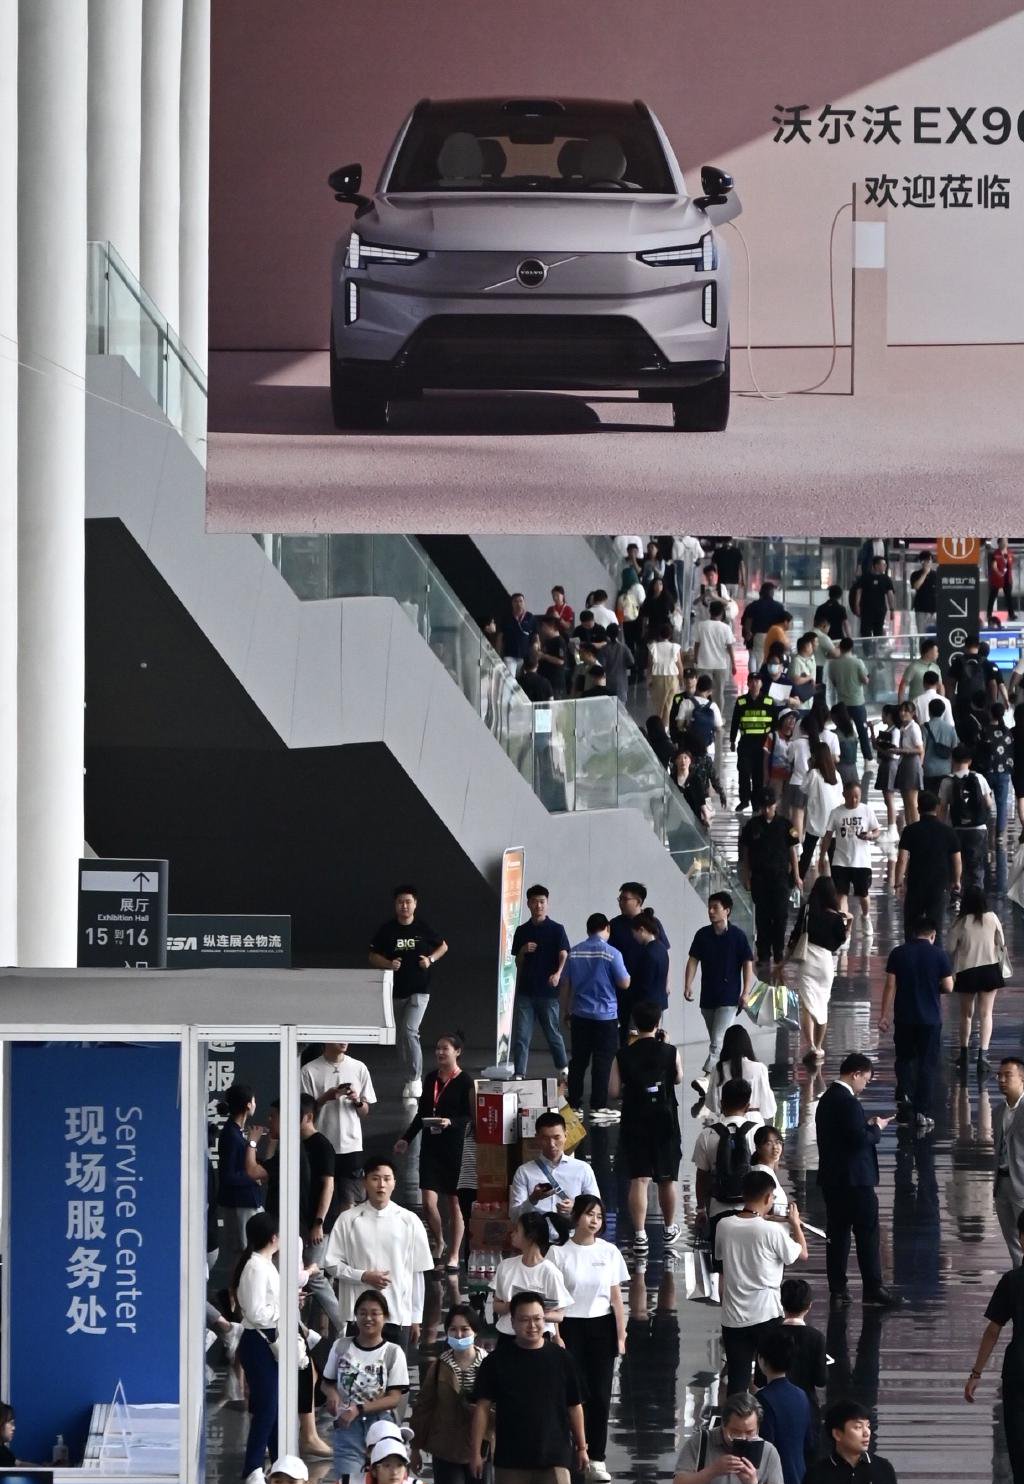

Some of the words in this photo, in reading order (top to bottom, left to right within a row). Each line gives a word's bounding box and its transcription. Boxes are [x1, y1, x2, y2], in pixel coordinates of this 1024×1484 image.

[864, 174, 1011, 210] 欢迎莅临
[841, 817, 862, 826] JUST
[120, 898, 149, 912] 展厅
[97, 914, 133, 922] Exhibition
[85, 927, 108, 946] 15
[126, 928, 149, 946] 16
[203, 934, 282, 948] 纵连展会物流
[396, 938, 416, 948] BIG
[115, 1106, 143, 1218] Service
[65, 1105, 108, 1336] 现场服务处
[115, 1228, 143, 1334] Center
